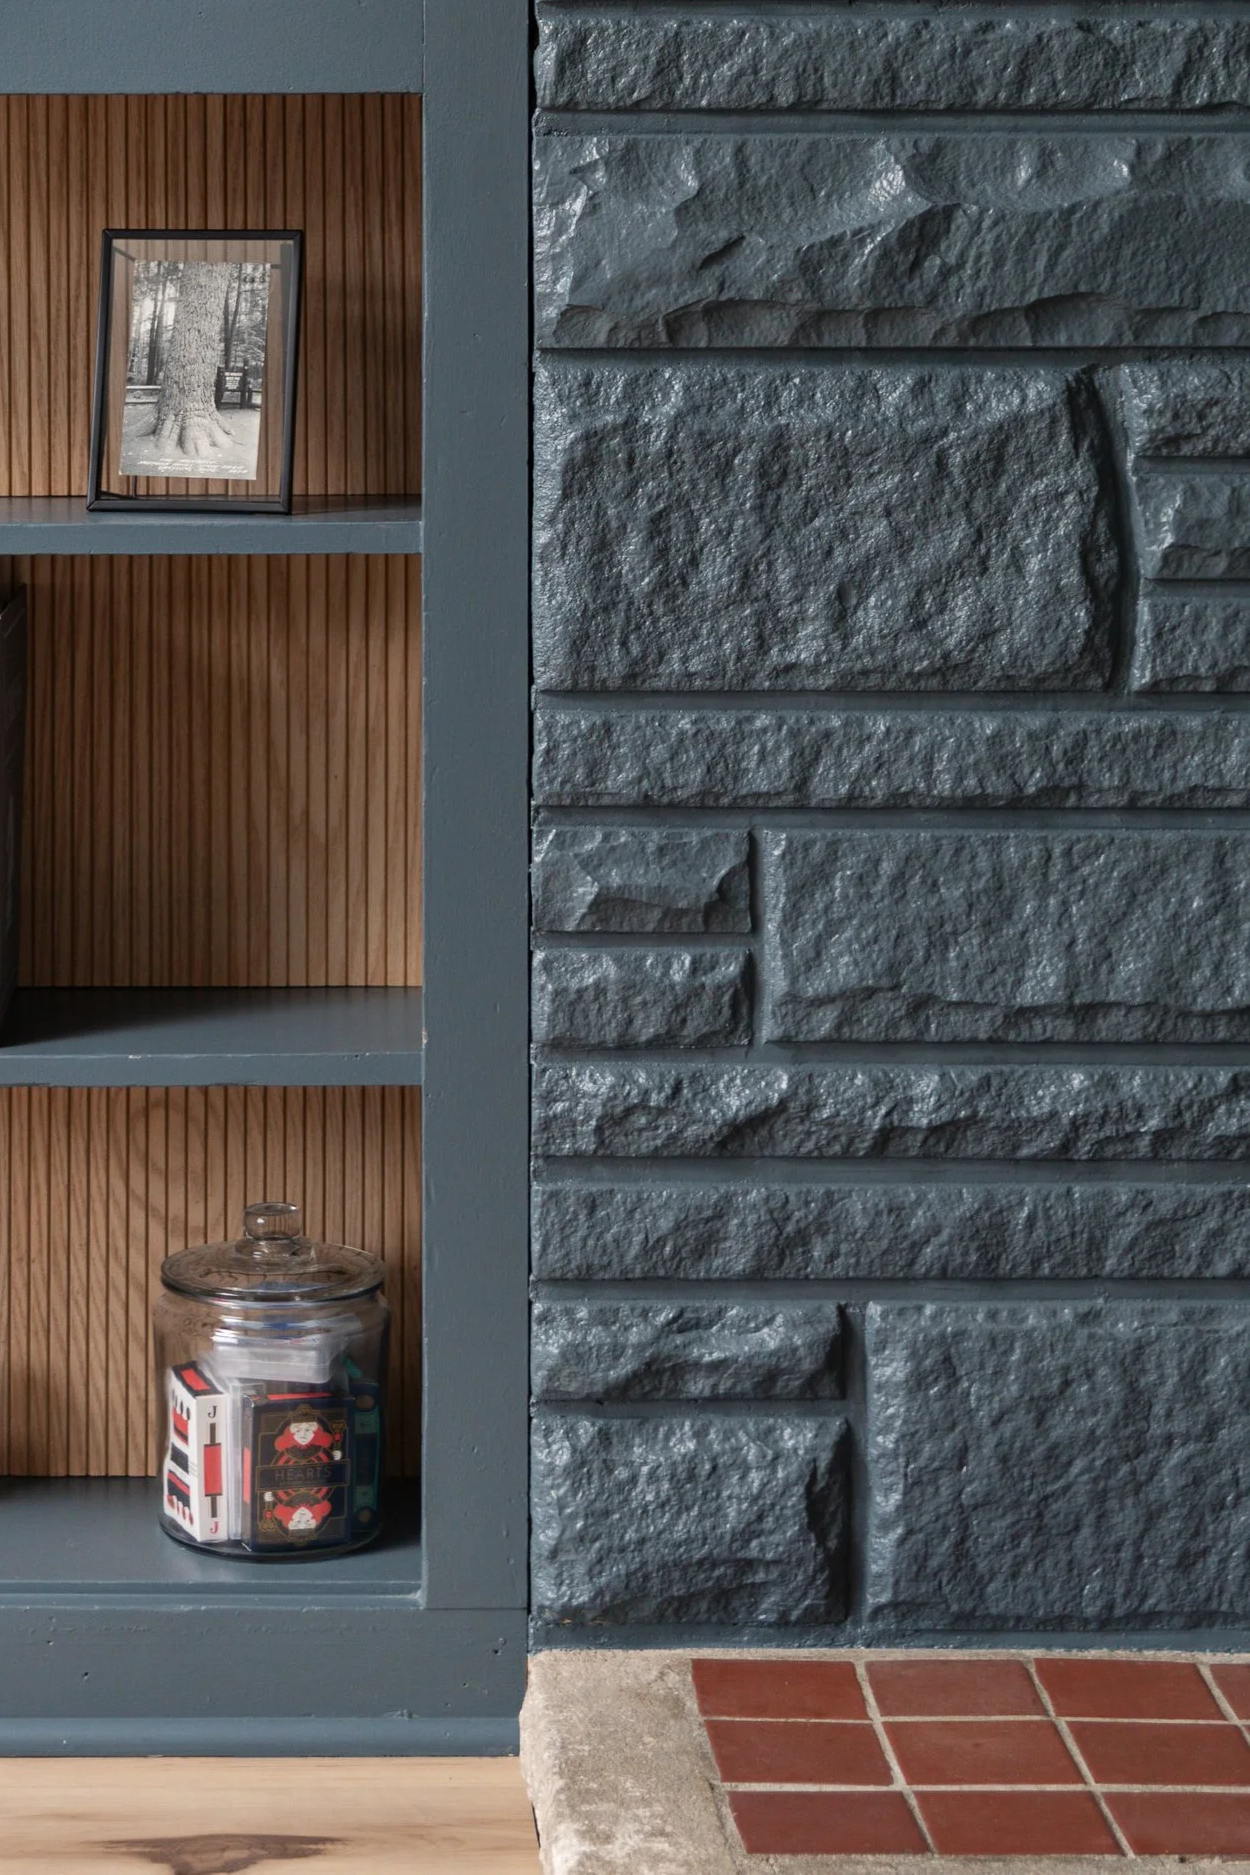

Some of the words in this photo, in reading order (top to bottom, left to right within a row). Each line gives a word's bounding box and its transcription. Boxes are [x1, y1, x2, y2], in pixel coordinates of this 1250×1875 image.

[207, 1405, 218, 1419] J
[274, 1467, 332, 1482] HEARTS
[209, 1520, 219, 1534] J
